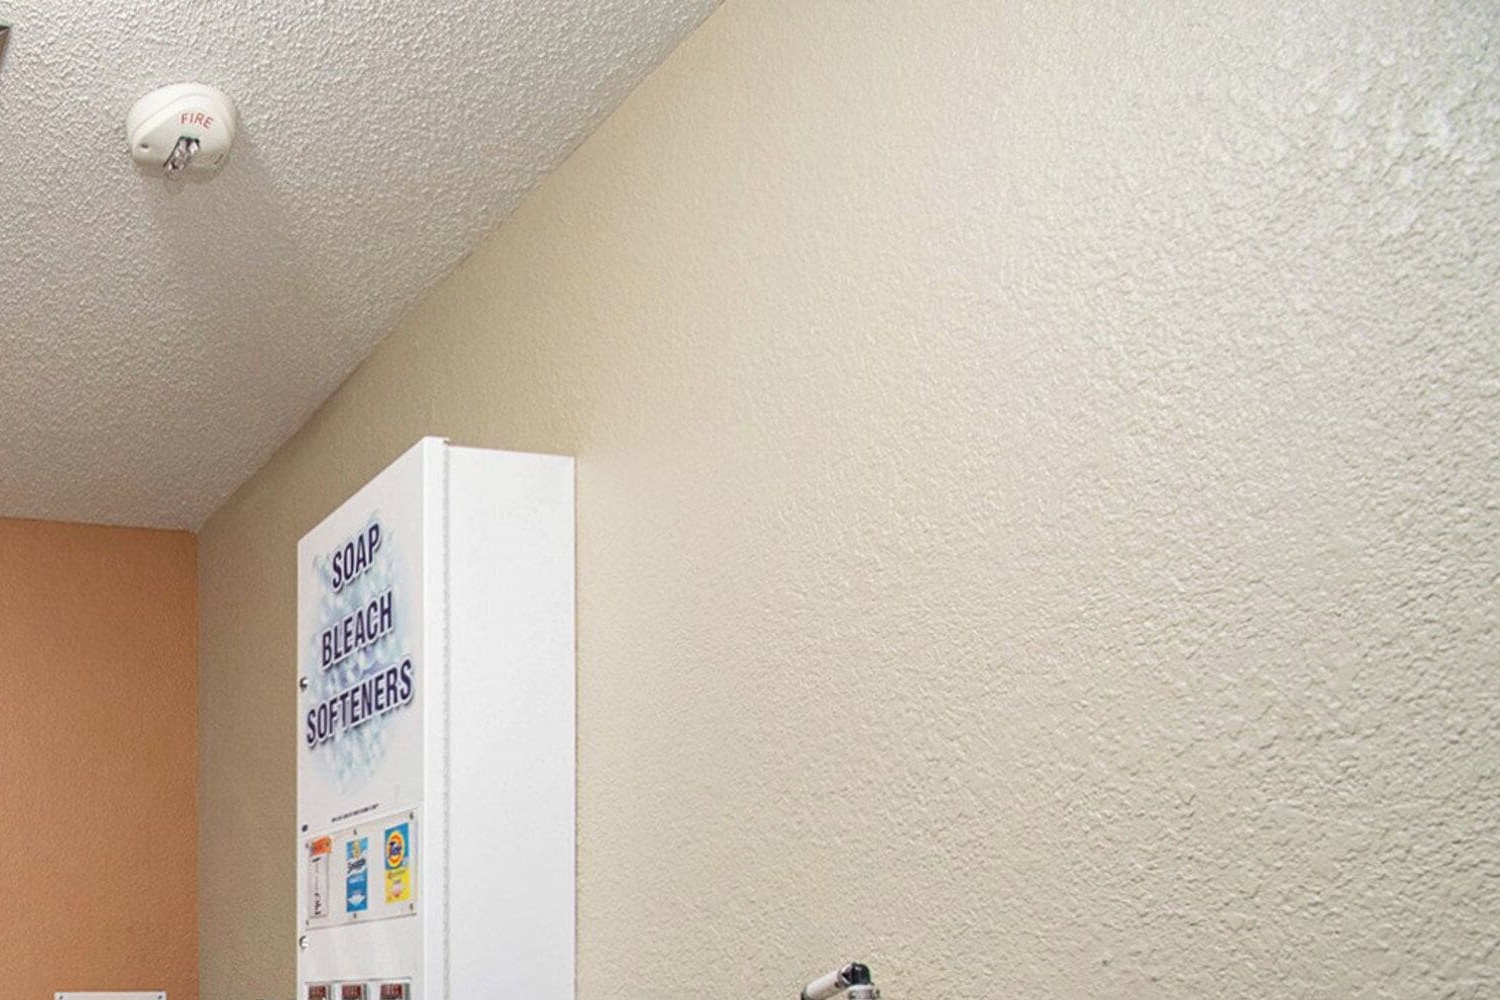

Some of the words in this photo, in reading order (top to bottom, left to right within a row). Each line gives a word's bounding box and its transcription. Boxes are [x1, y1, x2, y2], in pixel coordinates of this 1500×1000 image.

[181, 112, 214, 130] FIRE
[332, 523, 381, 589] SOAP
[322, 590, 394, 668] BLEACH
[306, 659, 412, 744] SOFTENERS
